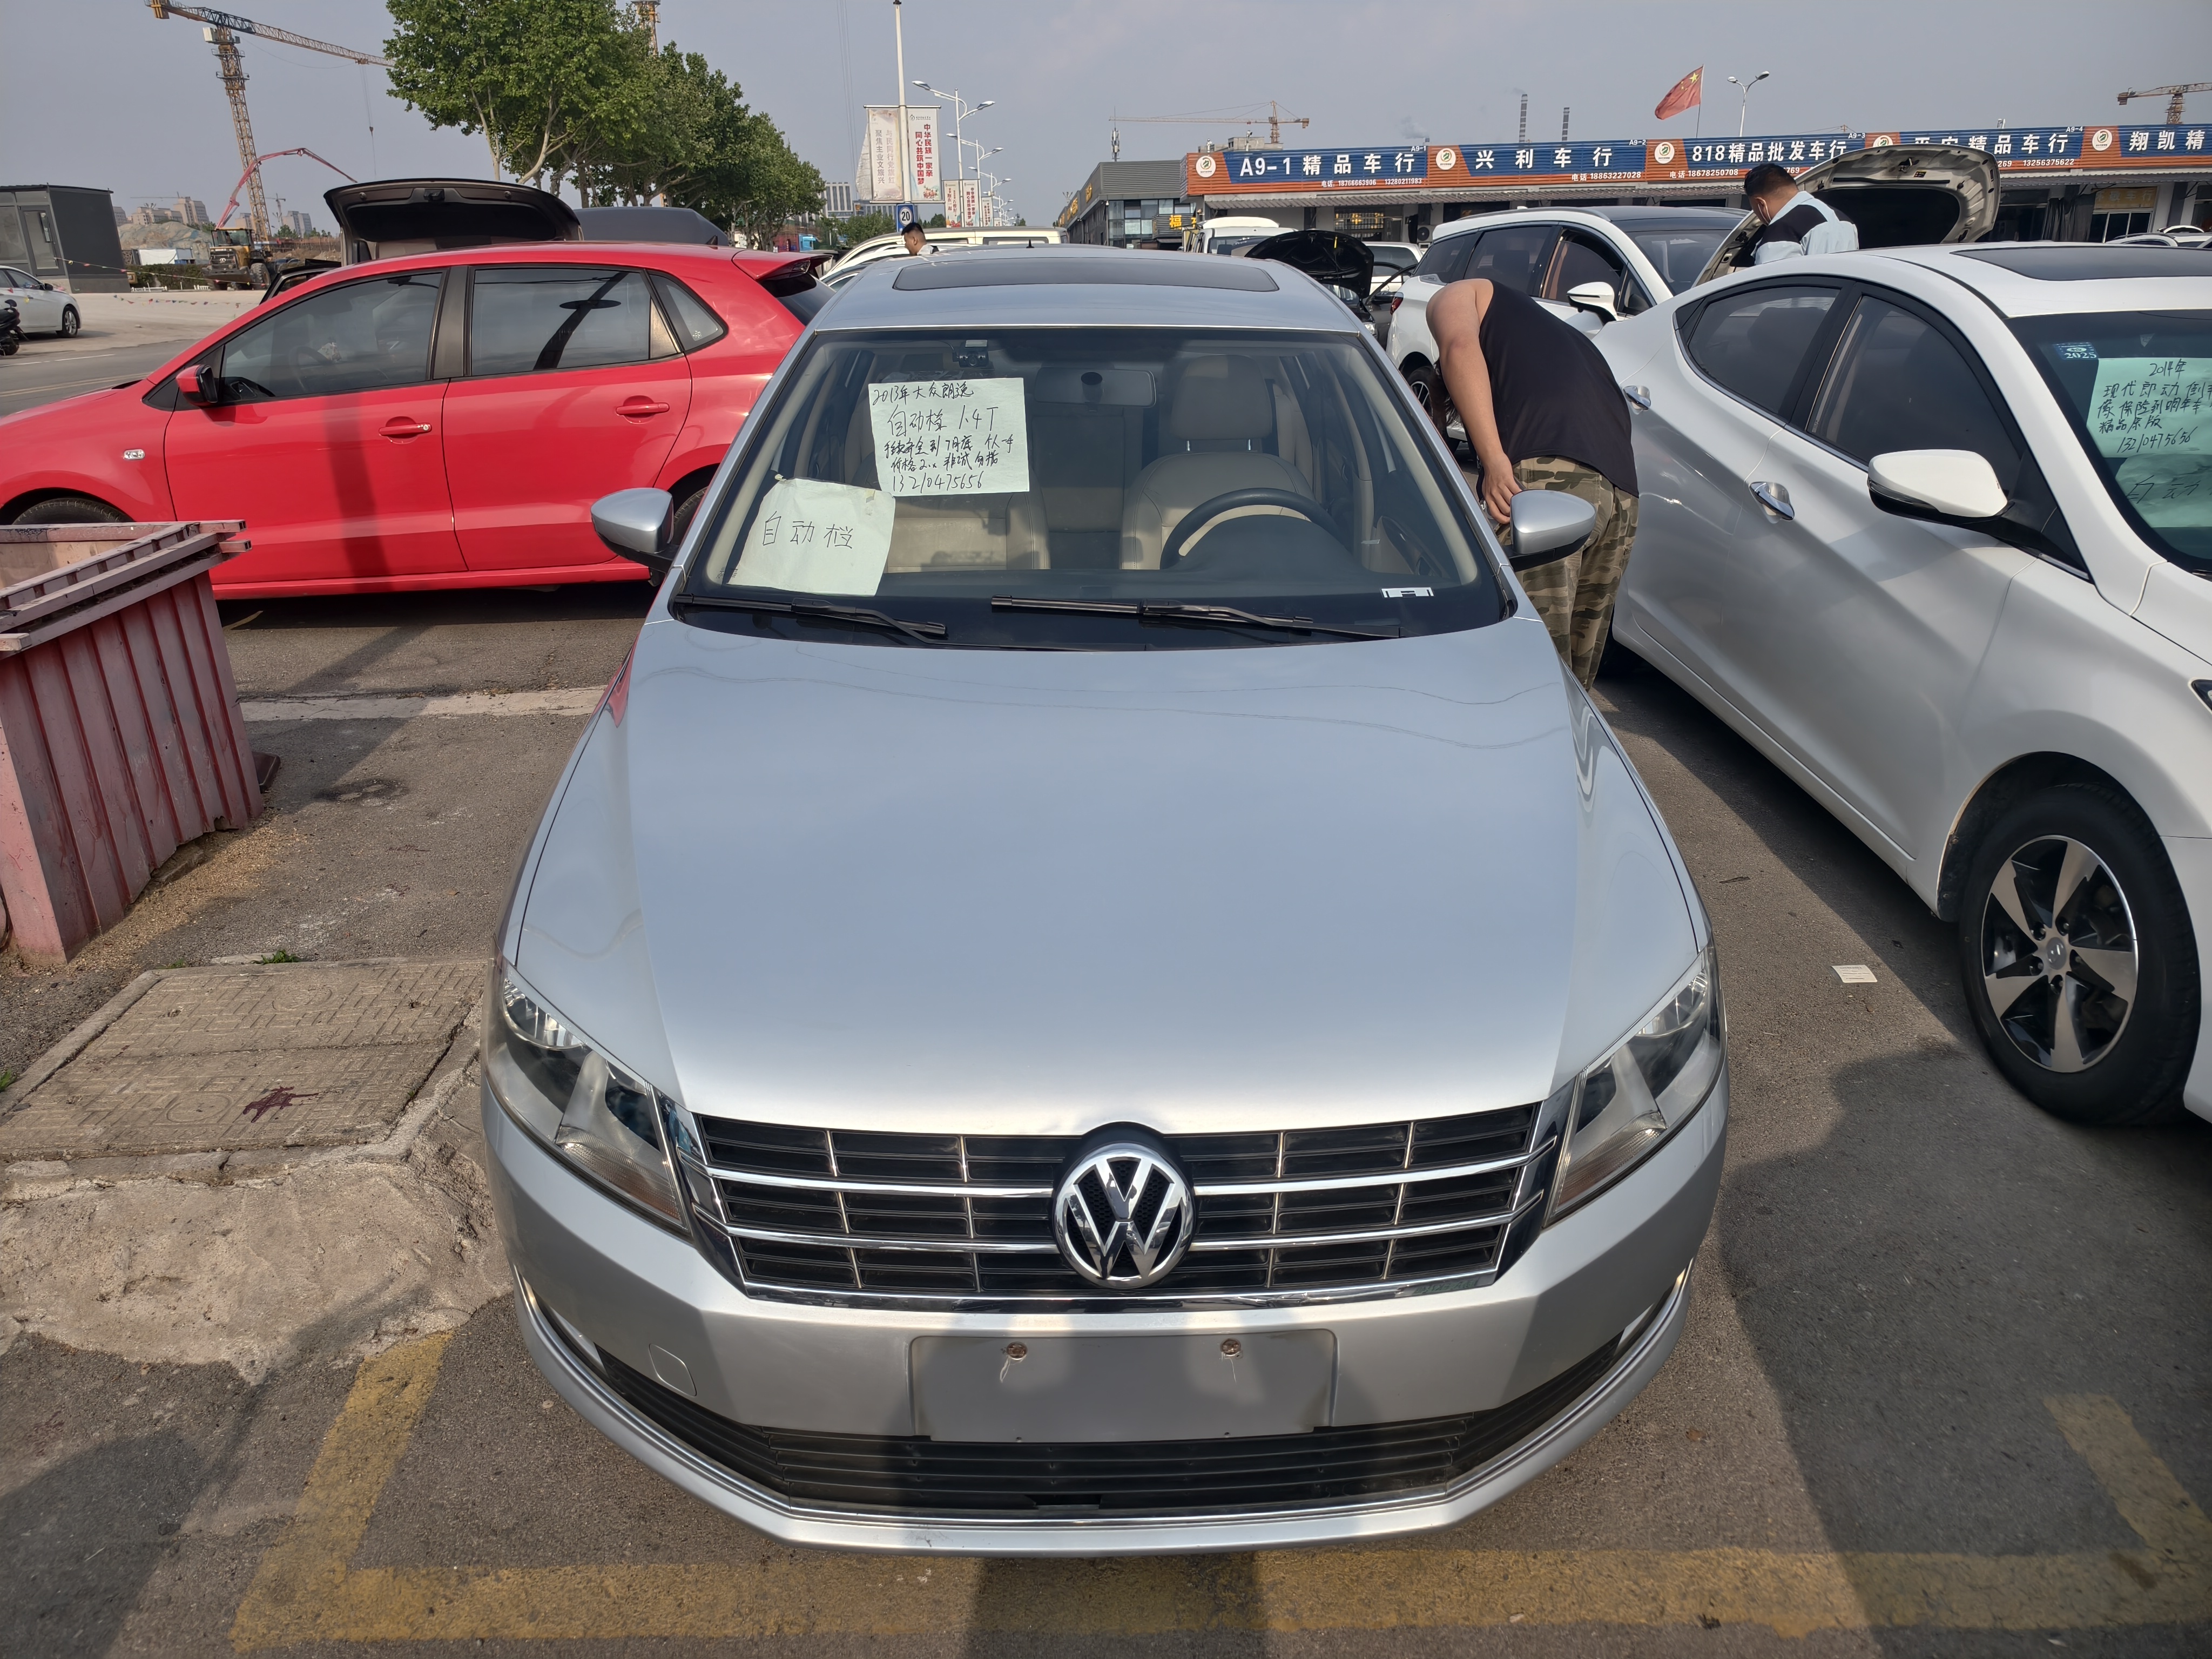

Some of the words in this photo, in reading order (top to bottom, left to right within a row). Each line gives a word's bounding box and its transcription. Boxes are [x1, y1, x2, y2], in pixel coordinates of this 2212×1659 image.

[924, 124, 933, 177] 中华民族一家亲
[2129, 130, 2205, 151] 翔凯精
[875, 130, 885, 184] 聚焦主业文旅兴
[915, 132, 924, 185] 同心共筑中国梦
[1476, 147, 1613, 169] 兴利车行
[1572, 173, 1587, 181] 电话
[1590, 171, 1642, 180] 18863227028
[1670, 171, 1685, 179] 电话
[1688, 169, 1738, 177] 18678250708
[901, 211, 911, 221] 20
[2148, 359, 2187, 379] 2014年
[763, 510, 853, 549] 自动档
